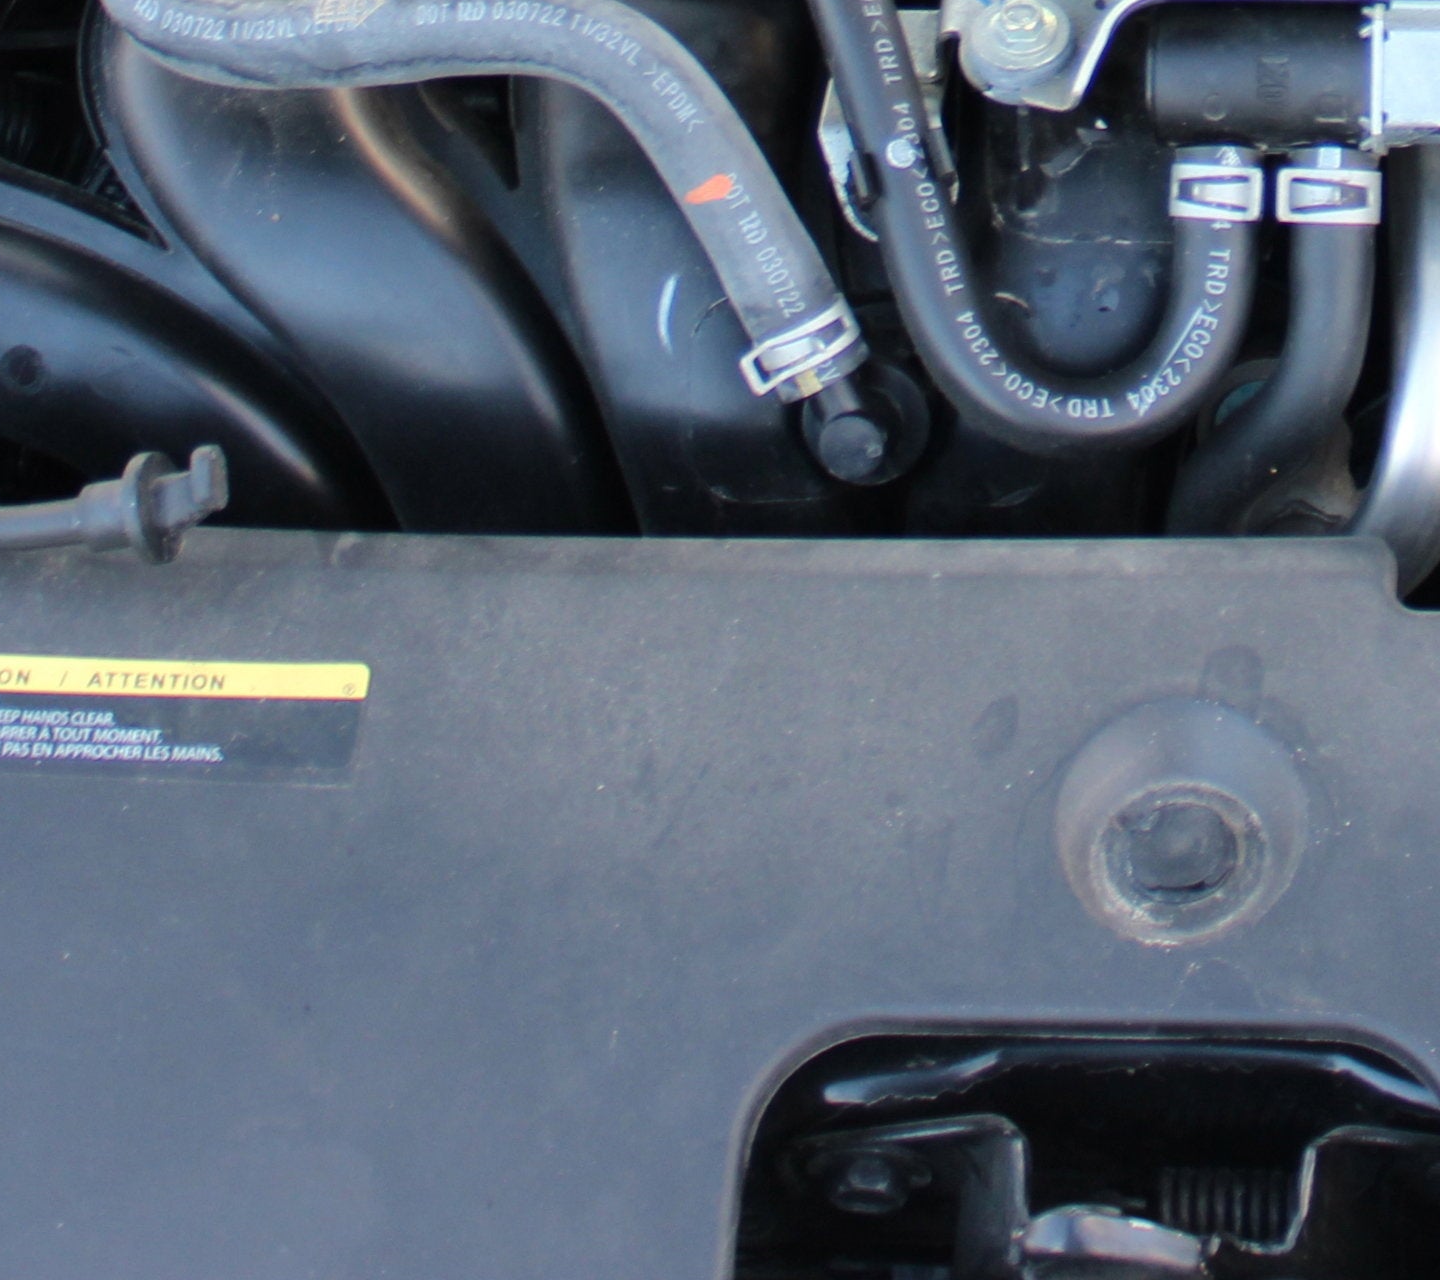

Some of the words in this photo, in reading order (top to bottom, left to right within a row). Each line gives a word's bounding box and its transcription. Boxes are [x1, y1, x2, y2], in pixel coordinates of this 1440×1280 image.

[491, 0, 568, 27] 030722
[756, 245, 807, 319] 030722
[86, 671, 226, 691] ATTENTION
[21, 710, 69, 725] HANDS
[52, 727, 92, 742] TOUT
[2, 743, 30, 758] PAS
[31, 743, 52, 758] EN
[53, 744, 142, 760] APPROCHER
[143, 746, 170, 761] LES
